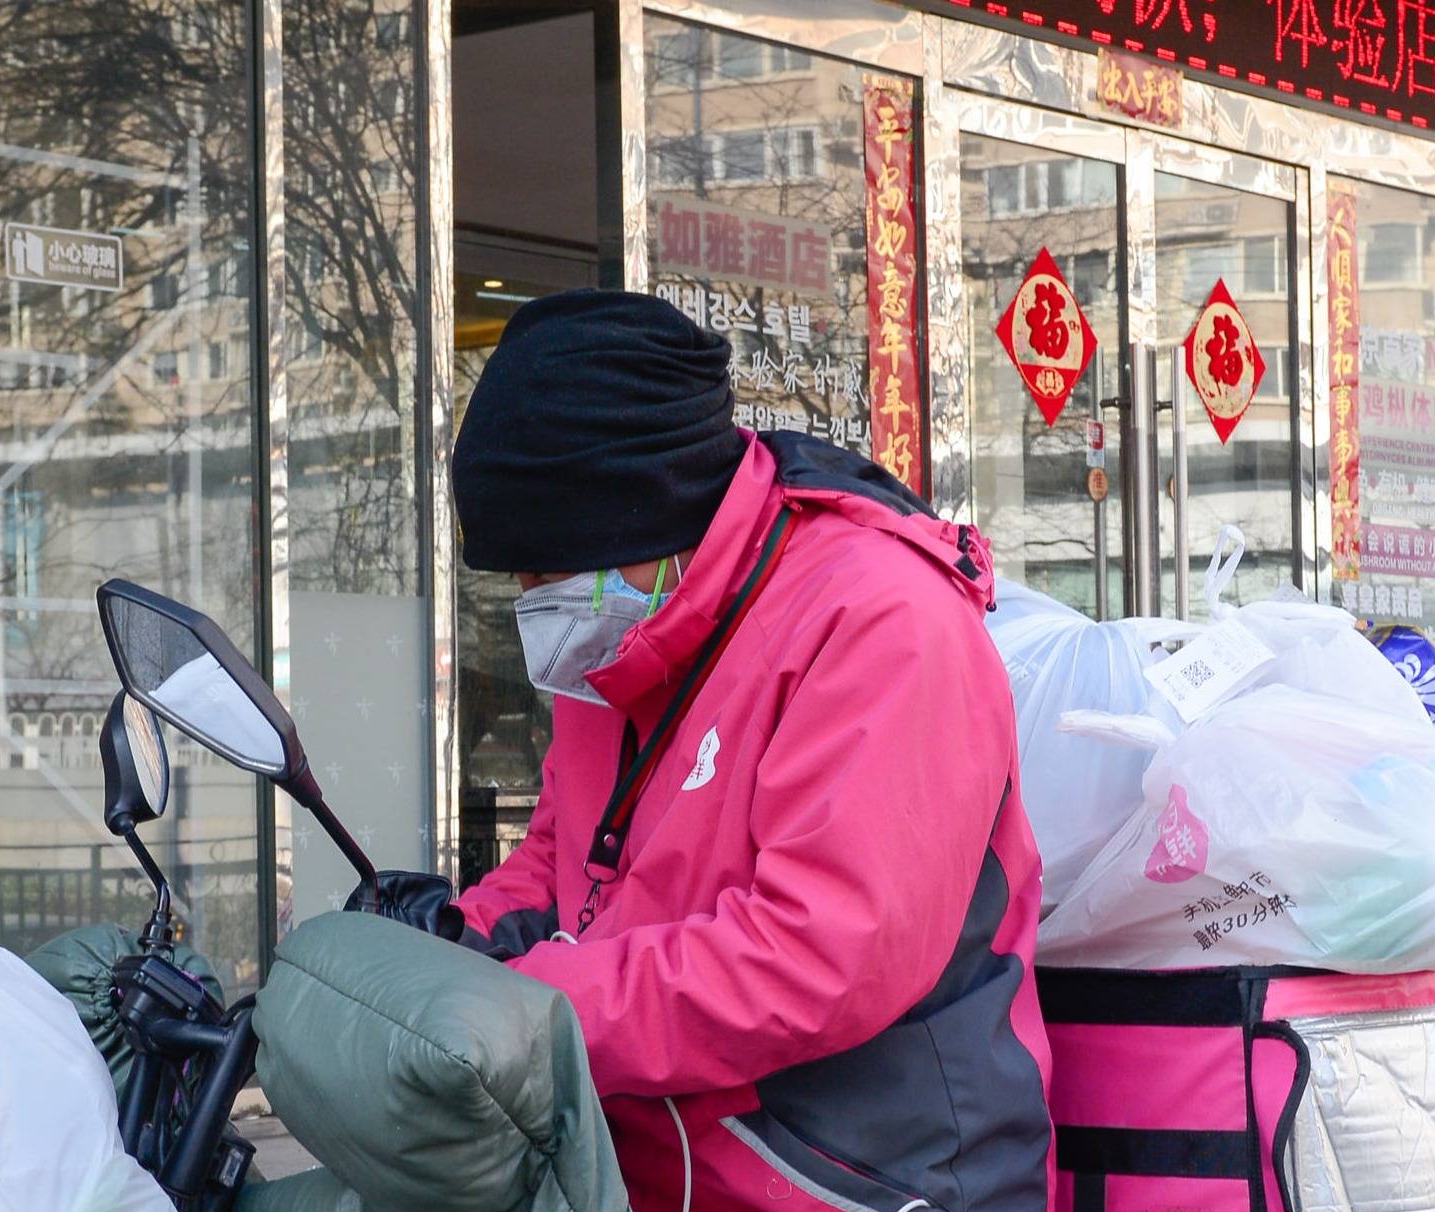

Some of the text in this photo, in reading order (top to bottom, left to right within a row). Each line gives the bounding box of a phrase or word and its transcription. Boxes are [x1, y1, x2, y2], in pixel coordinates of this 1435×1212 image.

[48, 241, 116, 269] 小心玻璃
[660, 200, 828, 290] 如雅酒店
[762, 303, 812, 343] 호텔
[874, 106, 913, 487] 平安如意年年好
[1026, 281, 1069, 360] 福
[1206, 313, 1244, 387] 福
[1360, 553, 1396, 569] USHROOM
[1397, 558, 1431, 573] WITHOUT
